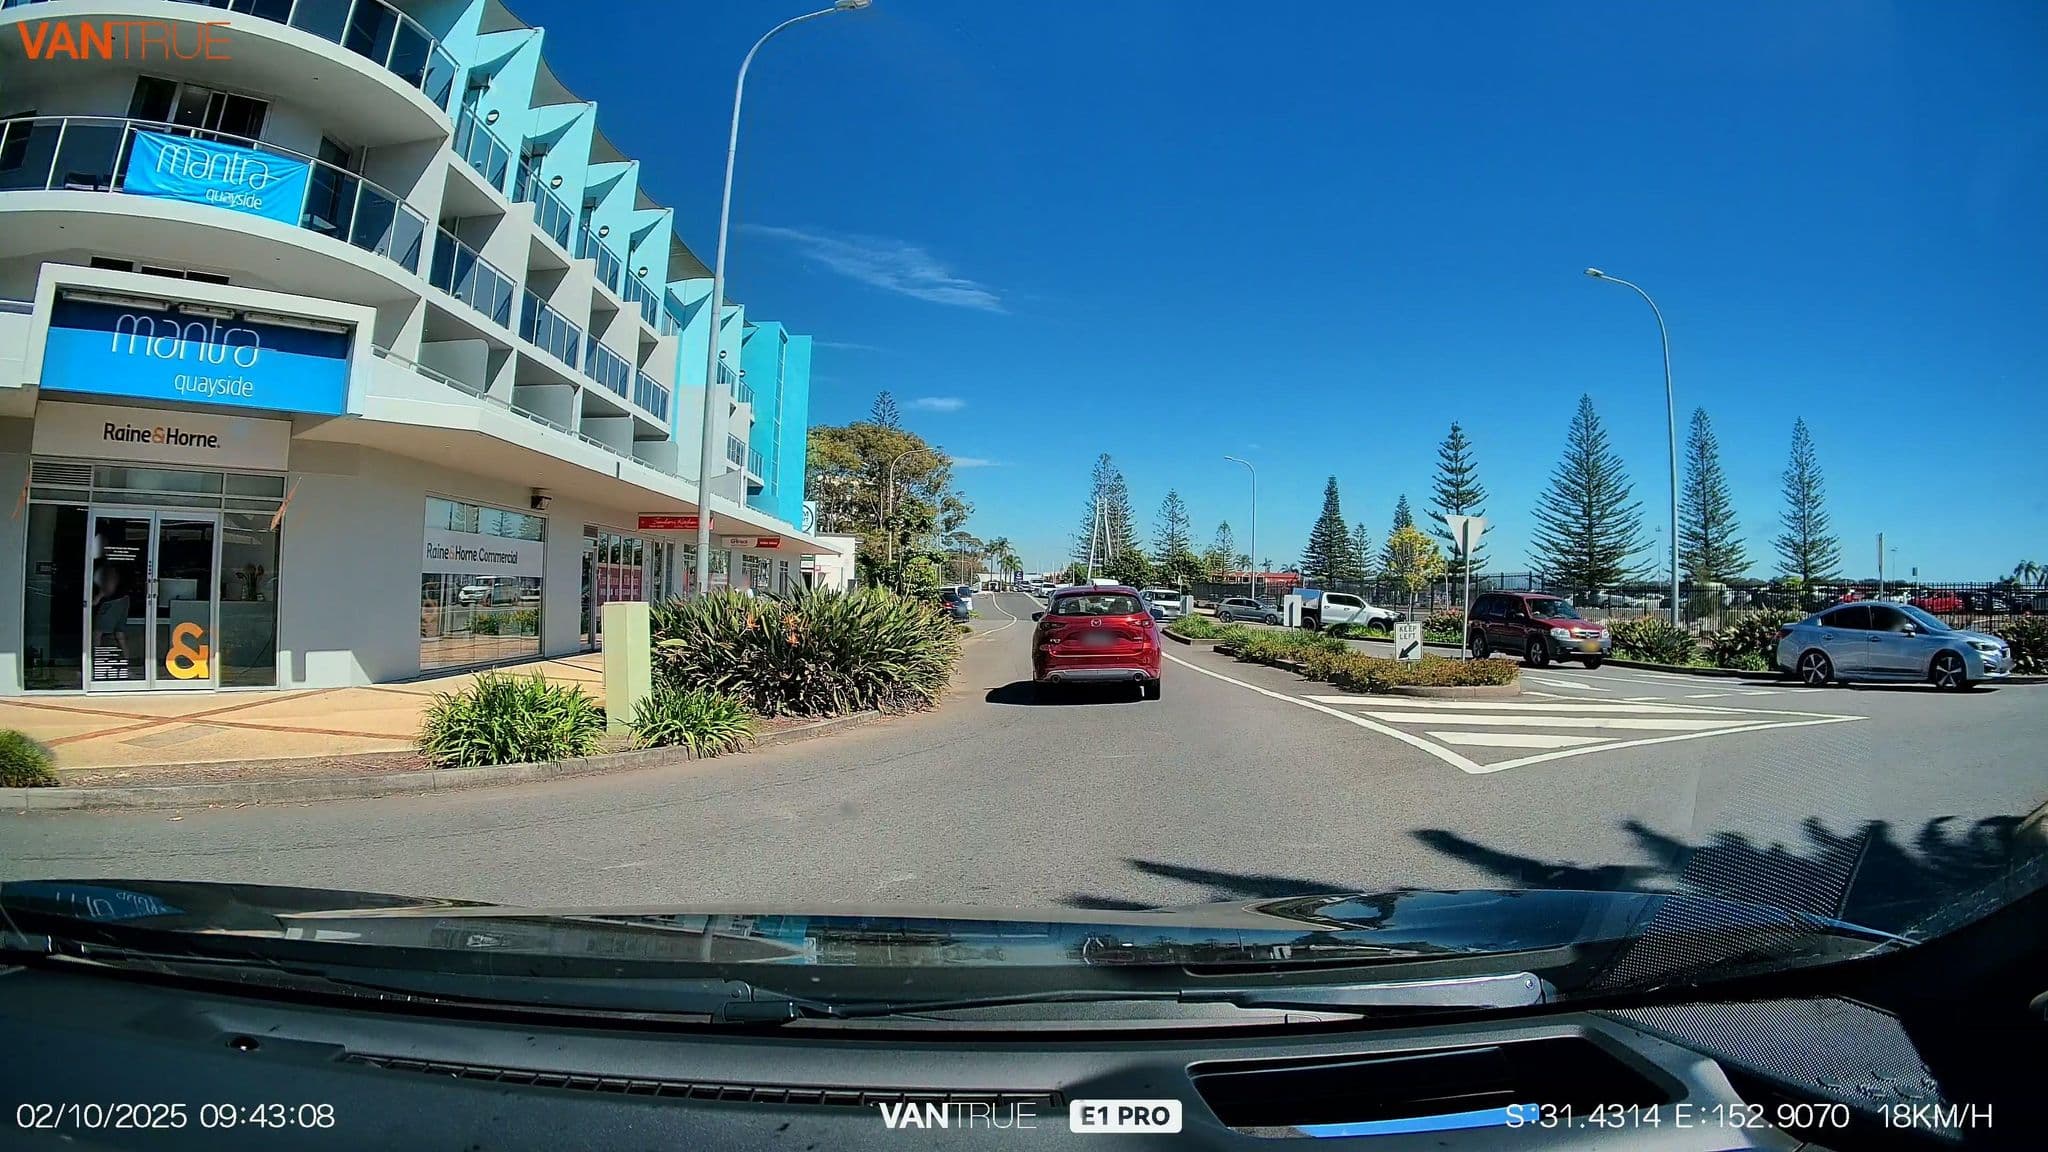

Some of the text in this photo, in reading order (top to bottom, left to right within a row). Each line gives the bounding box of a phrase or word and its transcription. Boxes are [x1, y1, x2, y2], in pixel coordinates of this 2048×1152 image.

[157, 143, 281, 190] mantra
[205, 187, 263, 210] quayside
[112, 314, 276, 368] mantra
[174, 374, 253, 398] quayside
[426, 542, 519, 564] Raine&Horne Commercial
